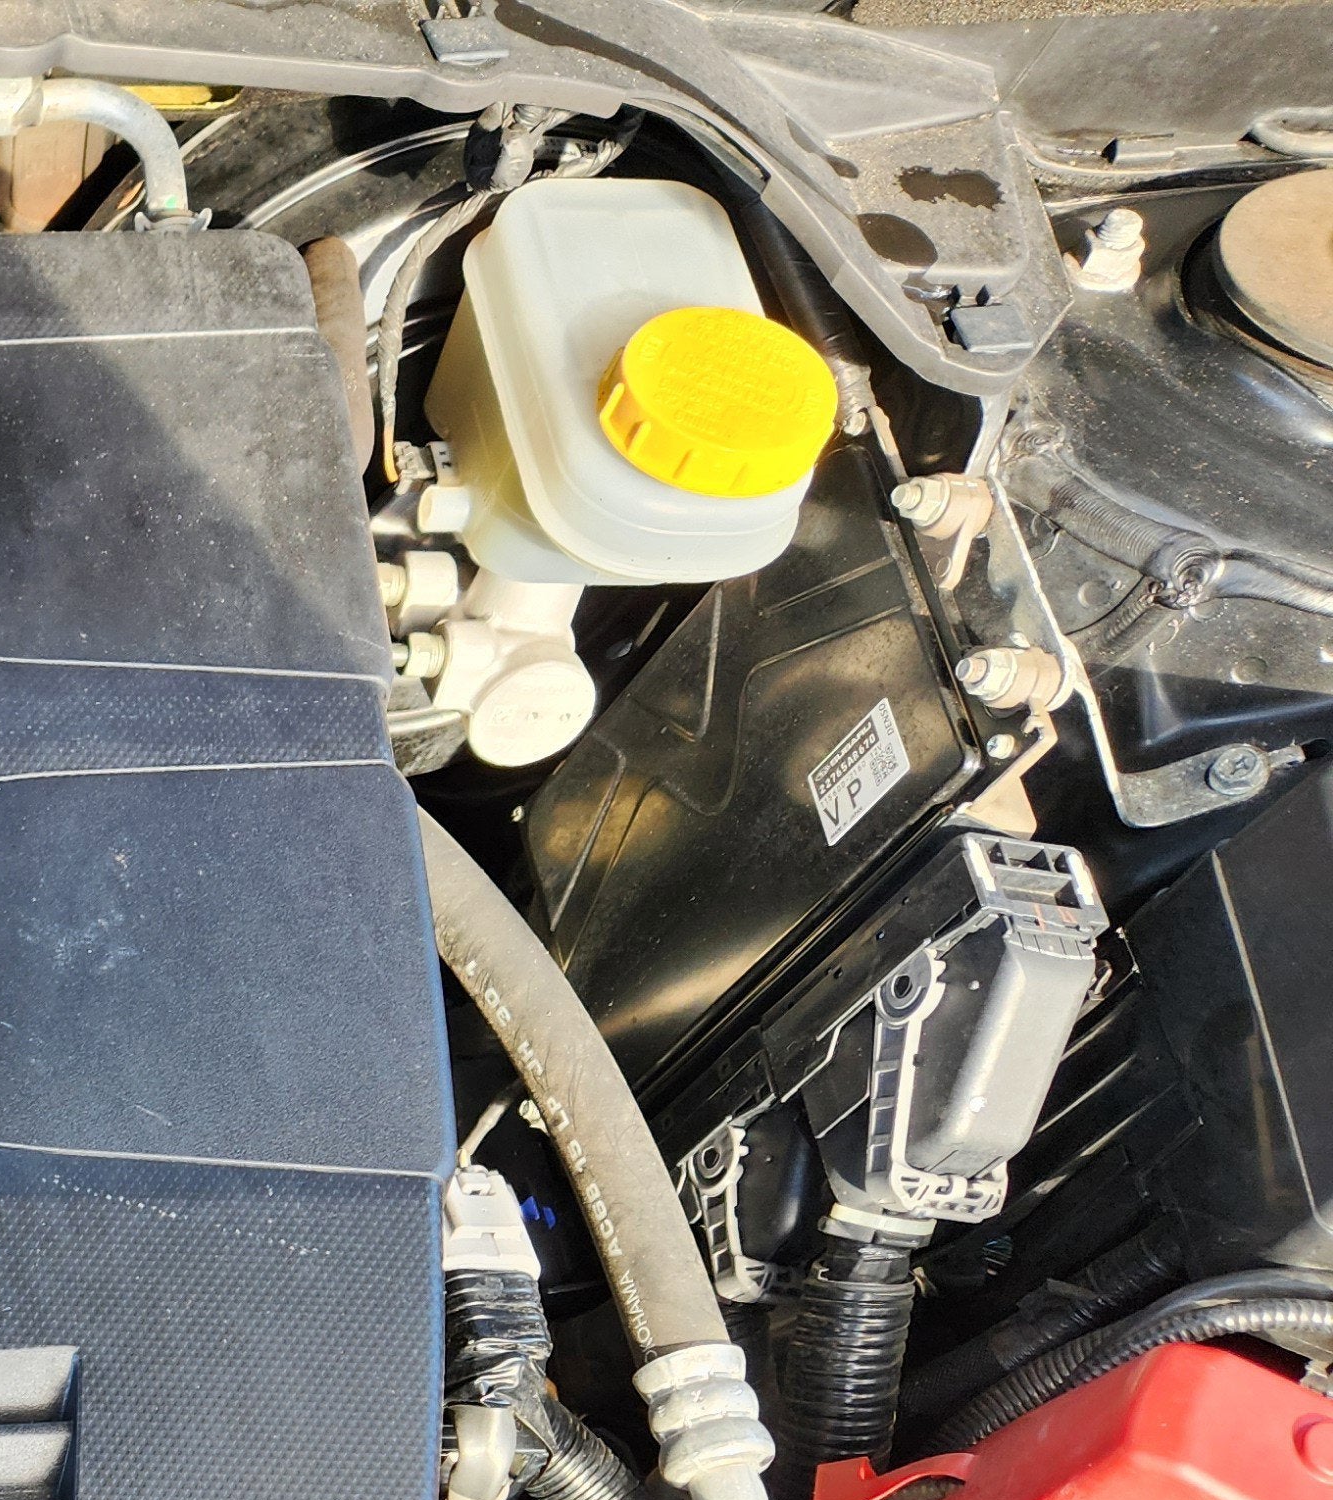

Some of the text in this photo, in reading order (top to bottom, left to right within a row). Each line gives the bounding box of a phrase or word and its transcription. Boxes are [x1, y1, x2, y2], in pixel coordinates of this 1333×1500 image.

[878, 703, 894, 736] DENSO
[829, 721, 872, 767] SUBARU
[823, 778, 862, 826] V P
